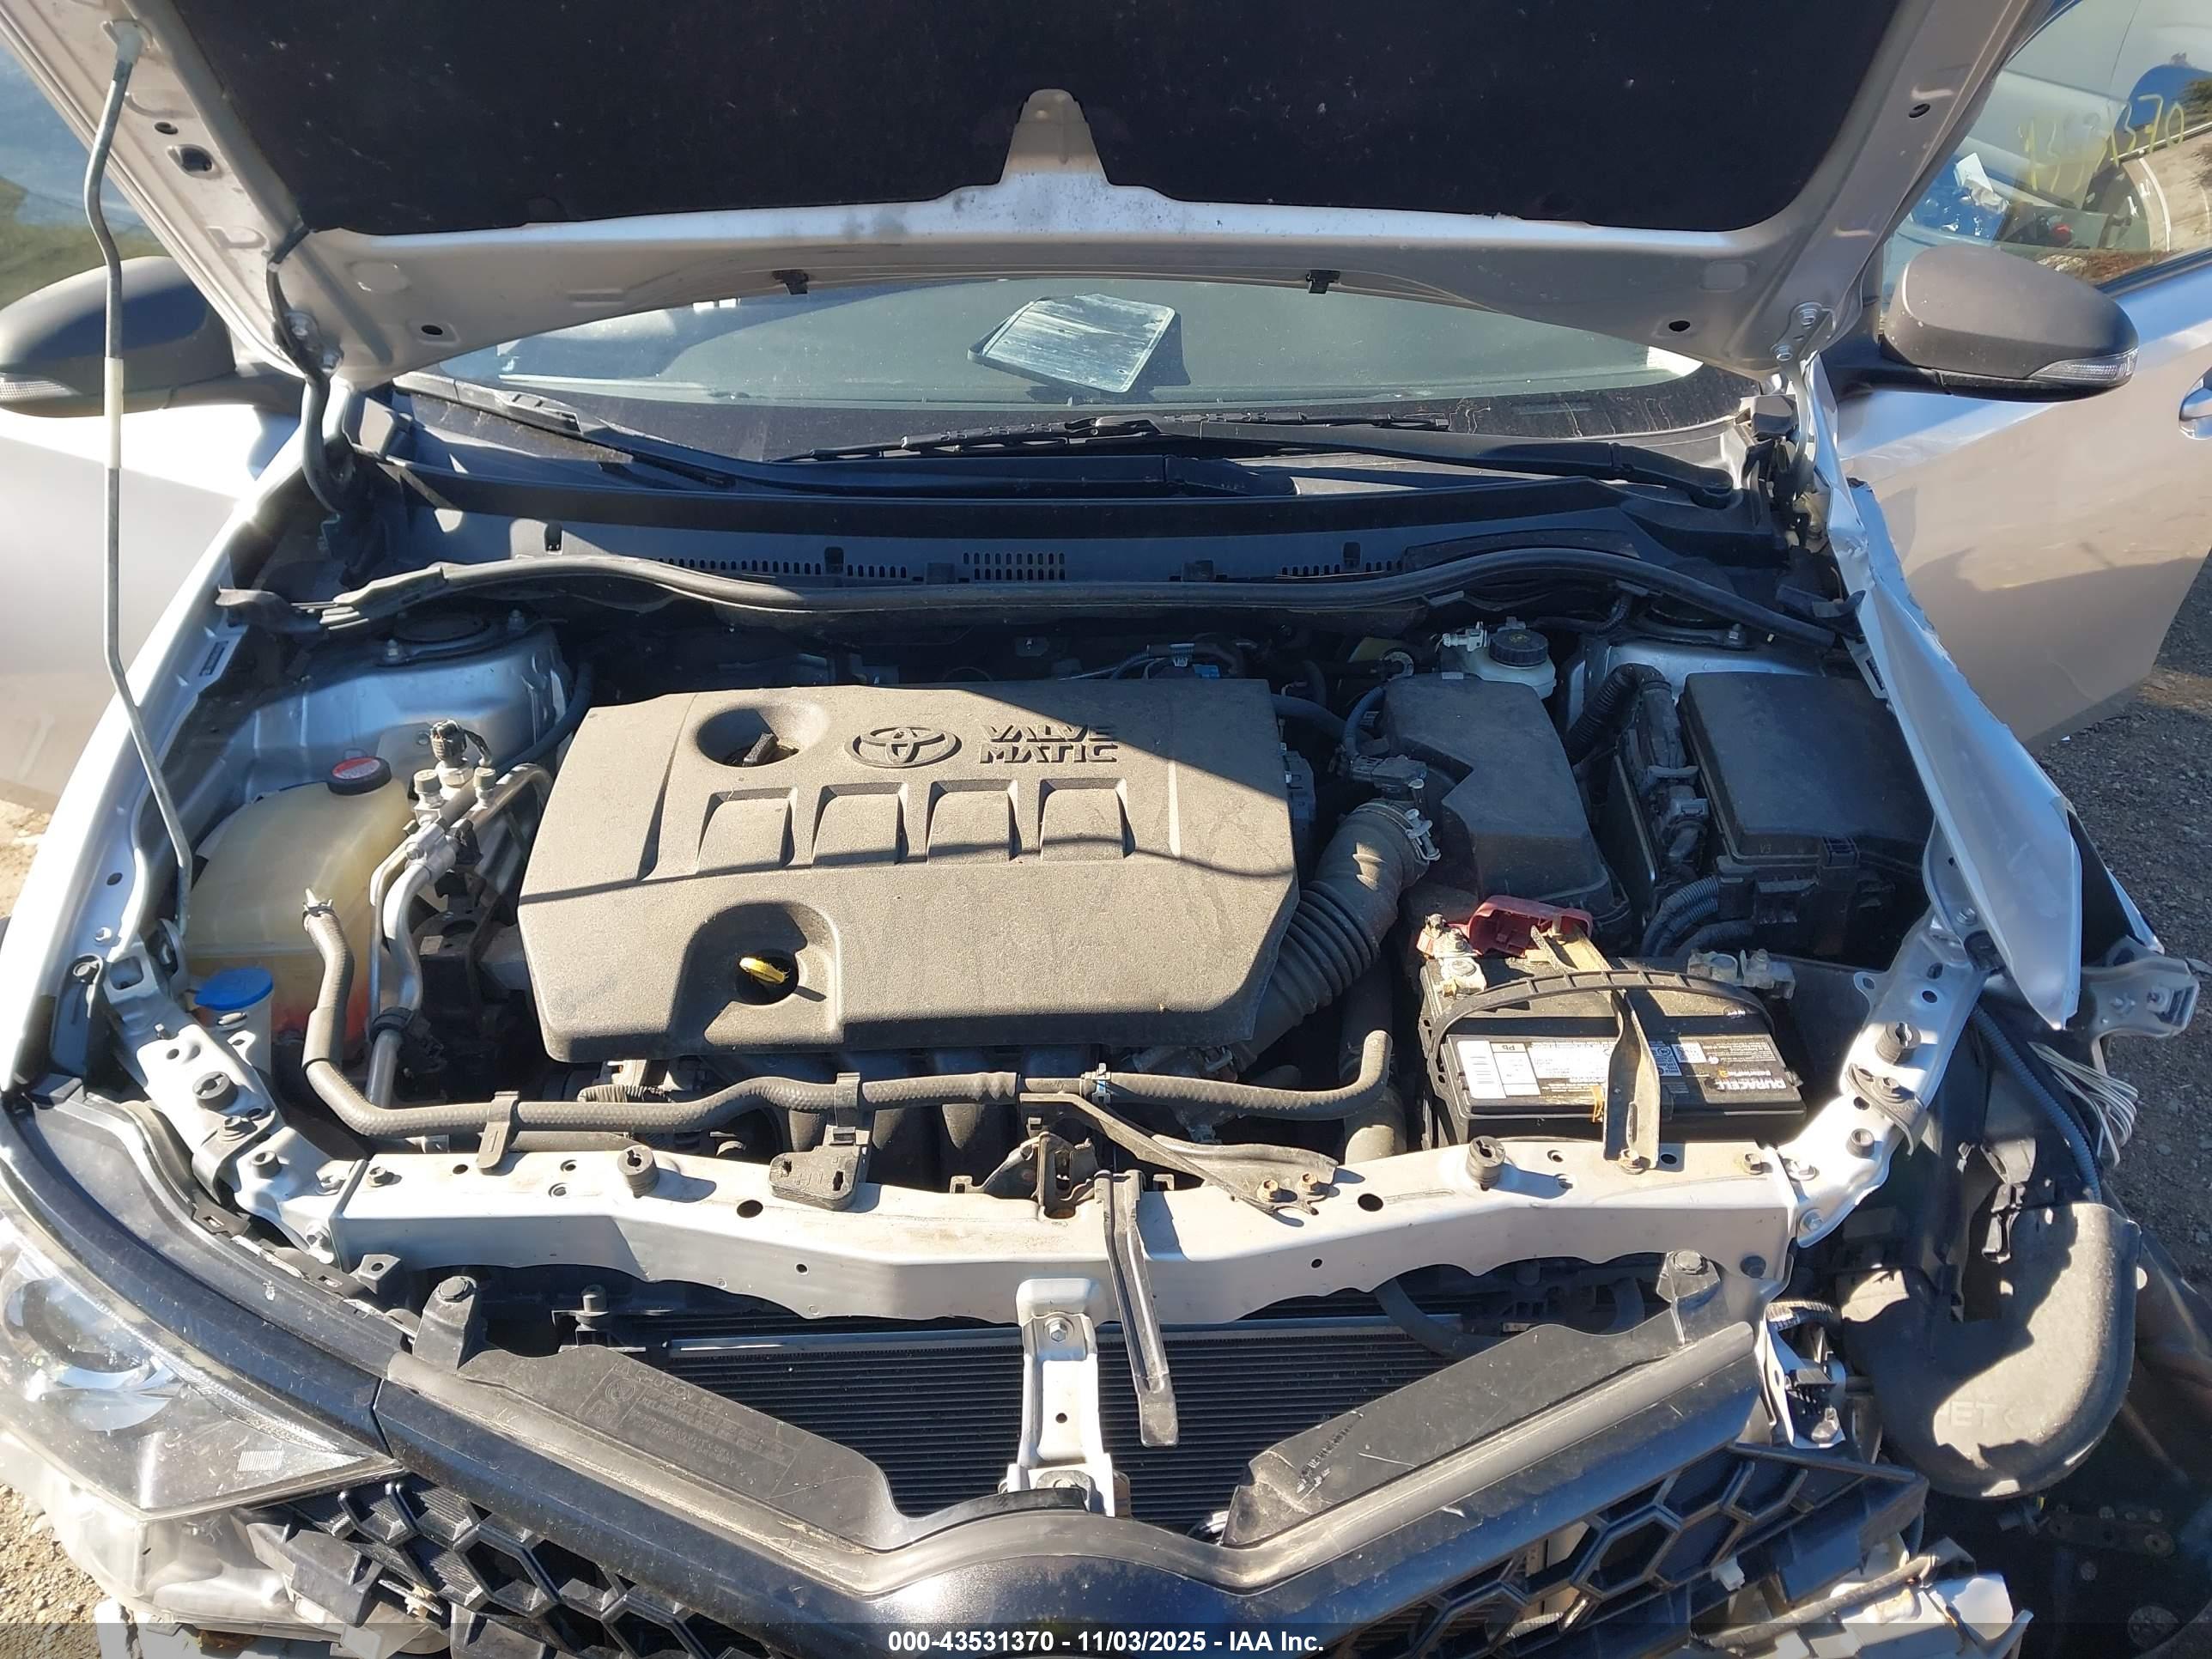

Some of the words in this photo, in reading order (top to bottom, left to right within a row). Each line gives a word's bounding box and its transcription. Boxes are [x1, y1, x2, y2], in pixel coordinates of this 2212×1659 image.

[981, 724, 1115, 742] VALVE
[979, 742, 1119, 764] MATIC
[1715, 1076, 1787, 1090] DURACELL
